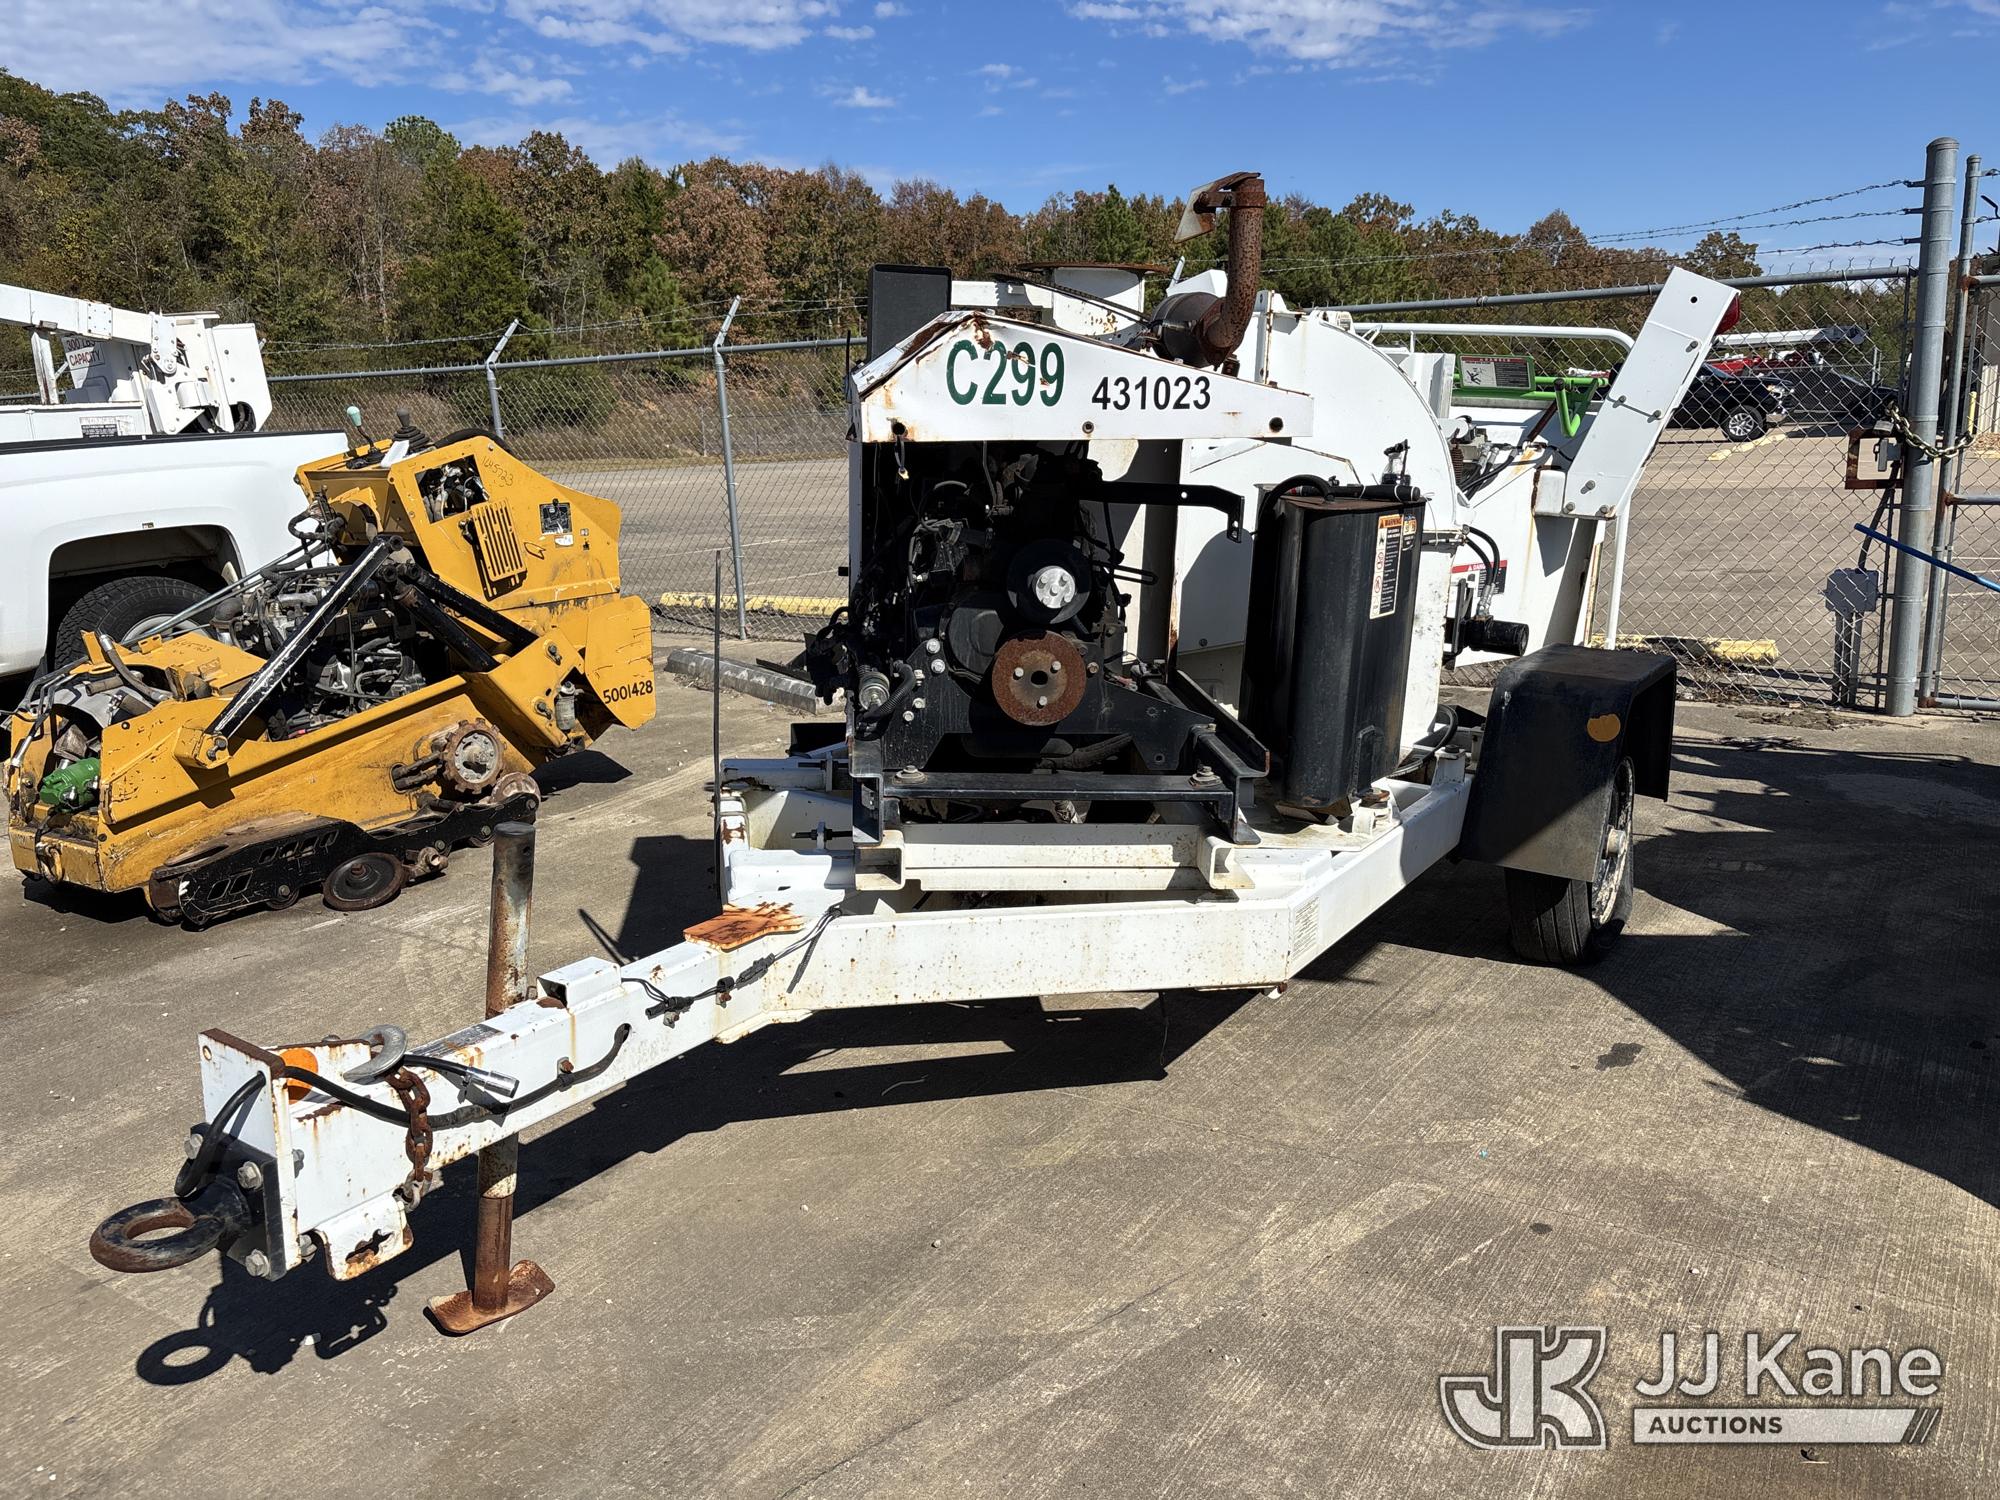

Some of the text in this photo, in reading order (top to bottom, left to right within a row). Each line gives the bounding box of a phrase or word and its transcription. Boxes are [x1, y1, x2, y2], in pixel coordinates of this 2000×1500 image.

[67, 338, 81, 351] 300
[69, 349, 101, 367] CAPACITY
[946, 339, 1211, 410] C299 431023
[603, 680, 654, 704] 5001428
